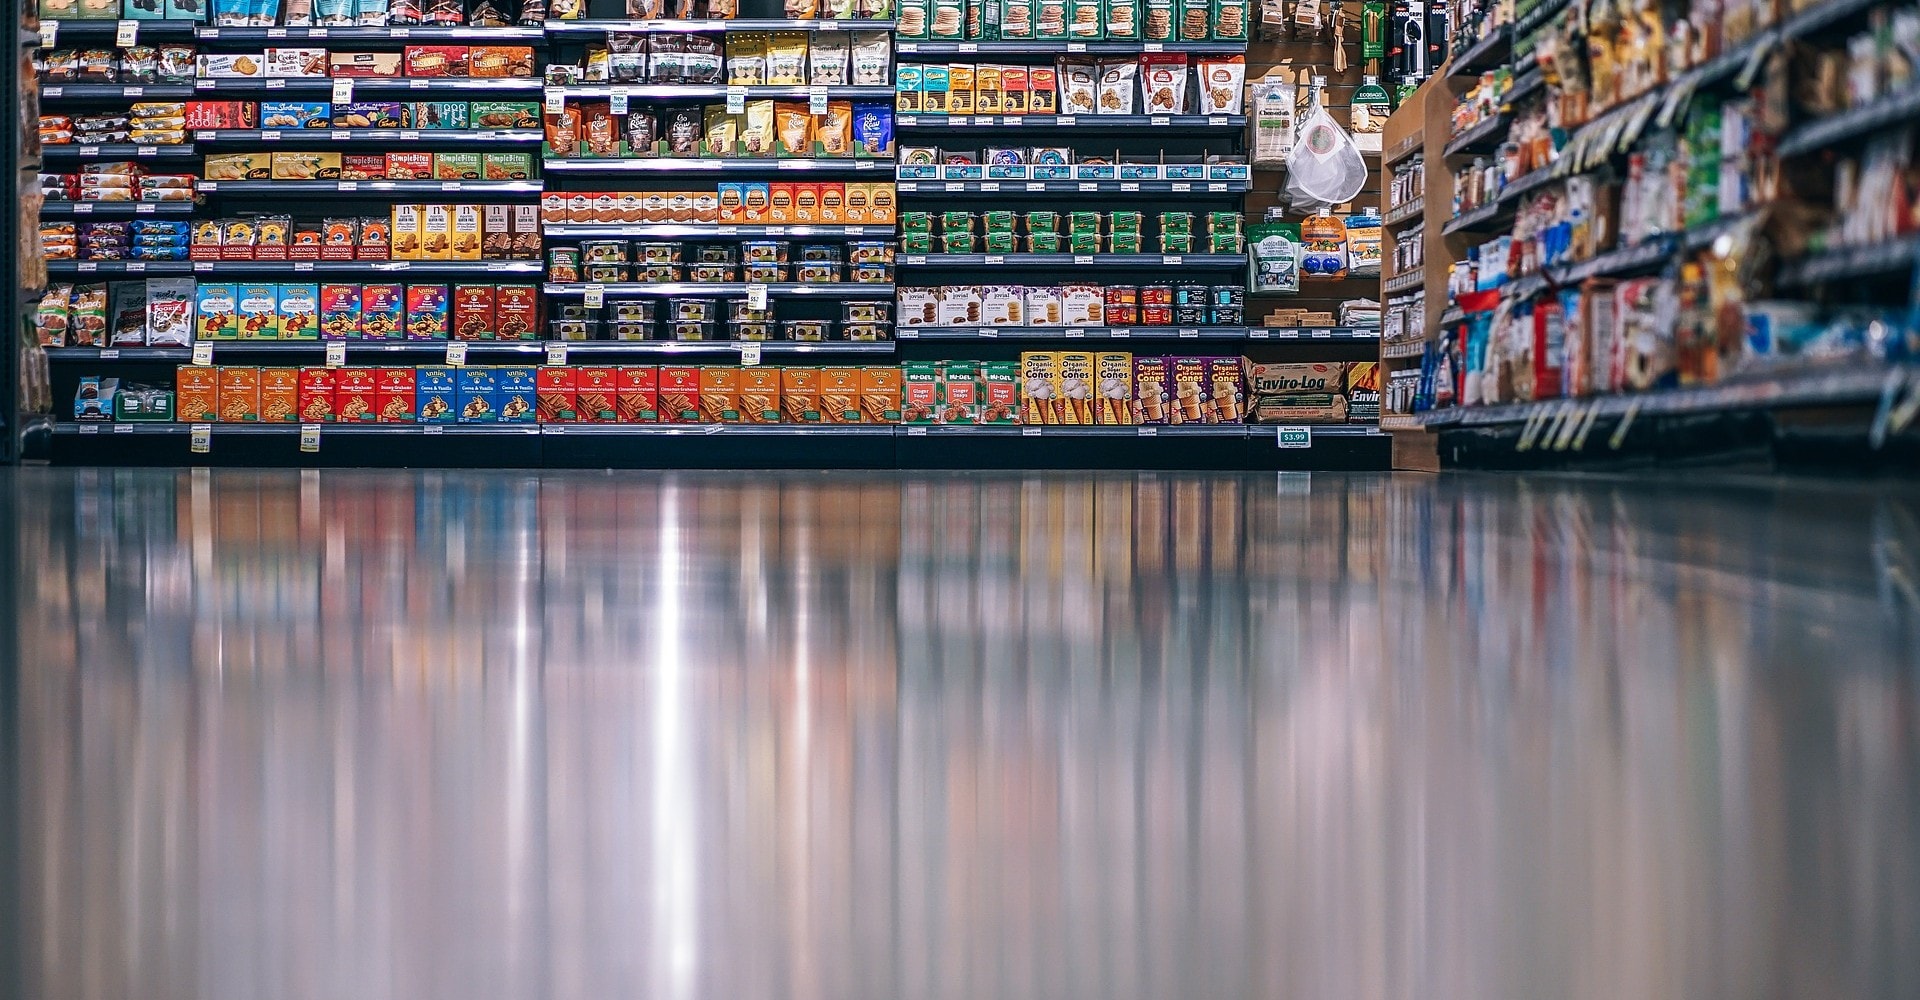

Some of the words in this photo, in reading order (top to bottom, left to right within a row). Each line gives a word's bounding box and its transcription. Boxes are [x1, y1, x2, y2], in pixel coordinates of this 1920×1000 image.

[473, 103, 489, 113] Ginger
[863, 120, 880, 130] Raw
[1255, 376, 1325, 390] Enviro-Log
